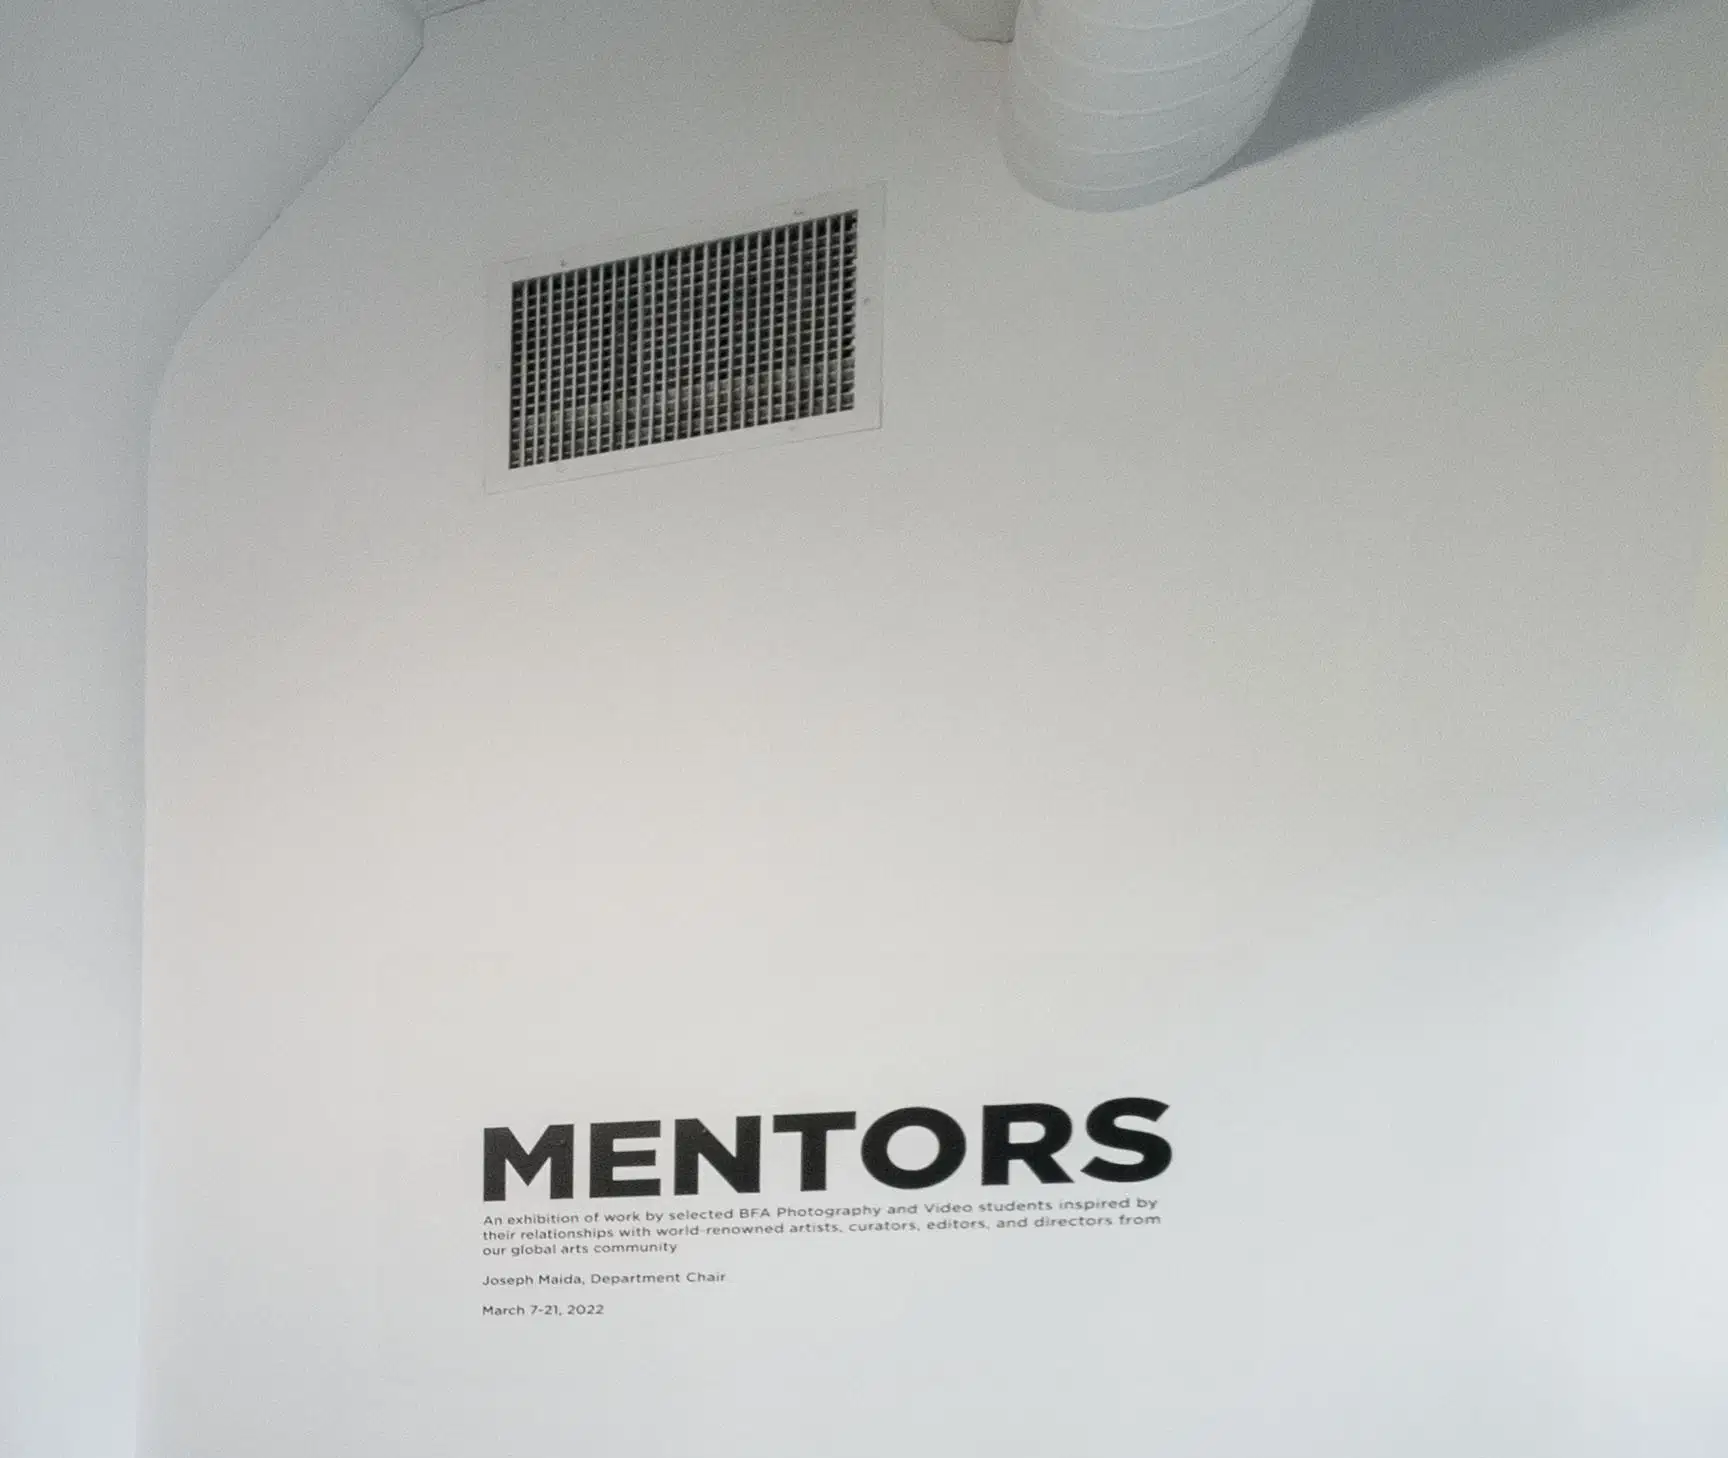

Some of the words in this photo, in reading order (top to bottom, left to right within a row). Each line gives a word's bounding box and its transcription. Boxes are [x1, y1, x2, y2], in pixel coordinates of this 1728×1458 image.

[483, 1097, 1173, 1202] MENTORS
[482, 1216, 503, 1226] An
[506, 1214, 580, 1226] exhibition
[583, 1212, 600, 1224] of
[603, 1212, 641, 1223] work
[645, 1211, 665, 1224] by
[668, 1209, 734, 1221] selected
[738, 1208, 772, 1219] BFA
[776, 1205, 882, 1219] Photography
[886, 1204, 919, 1215] and
[923, 1203, 974, 1214] Video
[977, 1201, 1054, 1213] students
[1058, 1198, 1131, 1212] inspired
[1135, 1198, 1159, 1211] by
[482, 1230, 517, 1241] their
[520, 1228, 615, 1241] relationships
[618, 1227, 652, 1238] with
[788, 1223, 844, 1234] artists,
[848, 1221, 921, 1233] curators,
[926, 1219, 990, 1231] editors,
[995, 1218, 1029, 1229] and
[1033, 1217, 1113, 1228] directors
[1118, 1214, 1162, 1226] from
[482, 1247, 507, 1257] our
[510, 1244, 557, 1258] global
[560, 1244, 589, 1255] arts
[481, 1275, 535, 1288] Joseph
[538, 1274, 586, 1286] Maida,
[590, 1273, 681, 1286] Department
[685, 1272, 727, 1283] Chair
[482, 1305, 526, 1317] March
[529, 1305, 563, 1317] 7-21,
[566, 1304, 605, 1316] 2022
